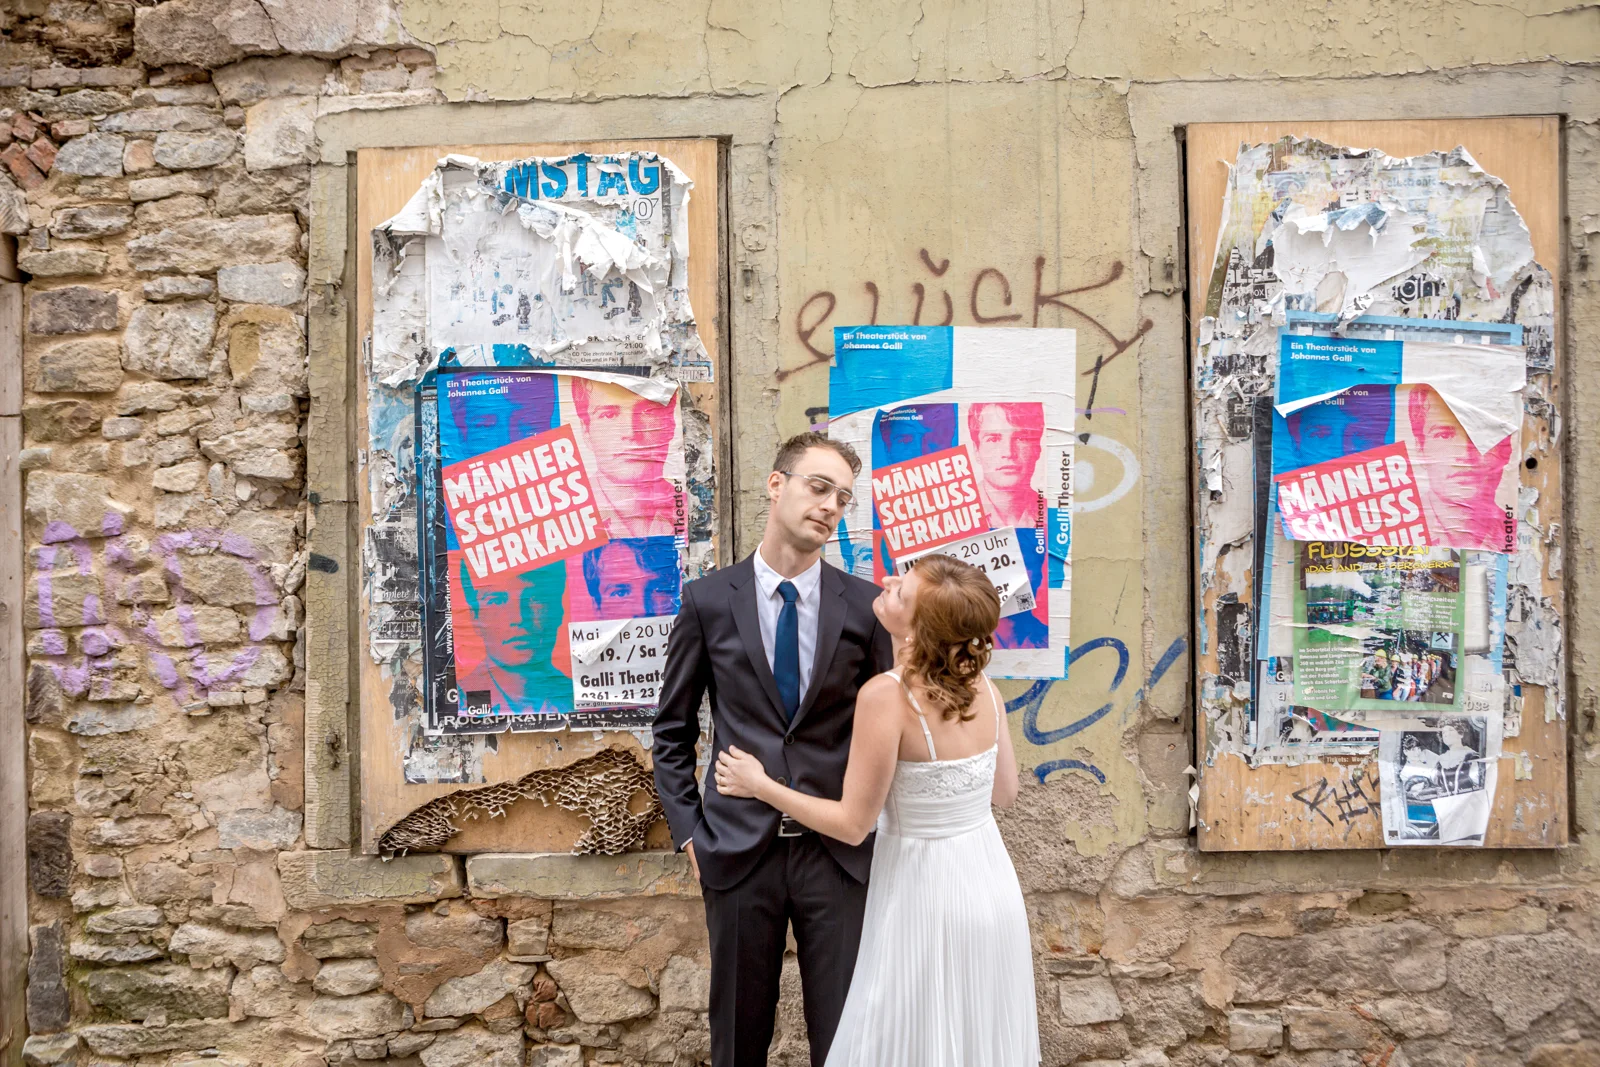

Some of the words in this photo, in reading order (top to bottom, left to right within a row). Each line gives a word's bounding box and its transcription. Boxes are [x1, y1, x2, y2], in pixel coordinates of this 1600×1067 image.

[855, 332, 909, 340] Theaterstück
[882, 342, 903, 350] Galli
[1290, 342, 1304, 350] Ein
[1305, 343, 1359, 353] Theaterstück
[1290, 352, 1330, 361] Johannes
[1332, 354, 1353, 362] Galli
[446, 380, 459, 388] Ein
[461, 375, 514, 386] Theaterstück
[446, 388, 487, 398] Johannes
[488, 386, 509, 394] Galli
[443, 438, 579, 509] MÄNNER
[872, 454, 971, 500] MÄNNER
[1279, 455, 1412, 516] MÄNNER
[455, 471, 589, 544] SCHLUSS
[879, 478, 977, 526] SCHLUSS
[1291, 488, 1420, 541] SCHLUSS
[885, 503, 982, 551] VERKAUF
[464, 505, 598, 579] VERKAUF
[961, 543, 980, 558] 20
[983, 536, 1009, 551] Uhr
[990, 554, 1016, 571] 20.
[1336, 562, 1388, 573] ANDERE
[571, 628, 600, 641] Mai
[635, 625, 654, 638] 20
[639, 644, 657, 658] Sa
[579, 671, 615, 688] Galli
[621, 689, 635, 700] 21
[640, 688, 655, 698] 23
[467, 702, 493, 716] Galli
